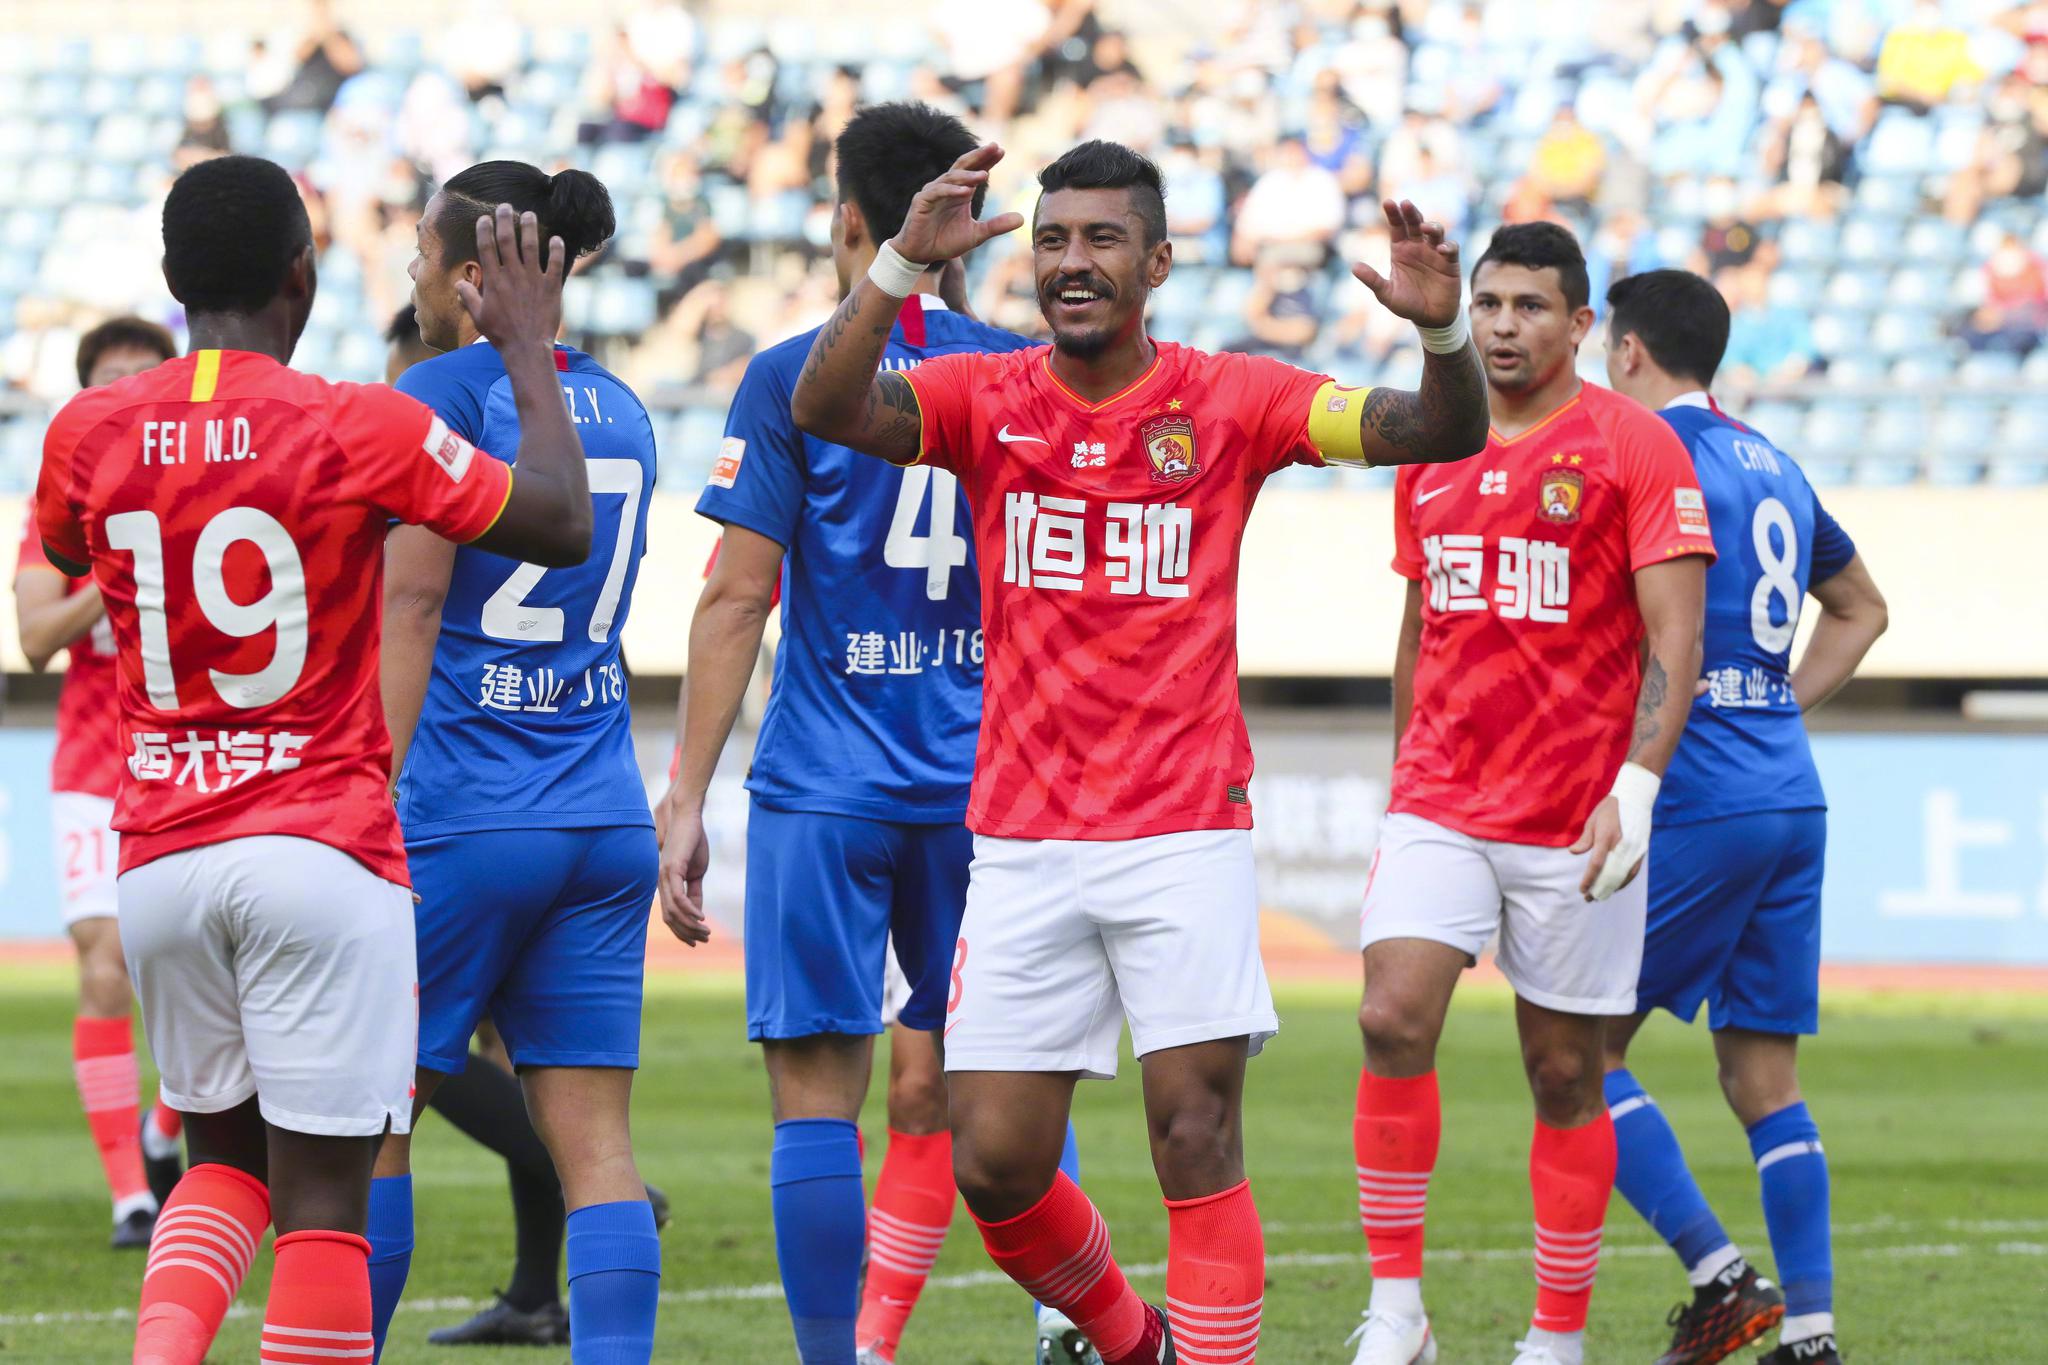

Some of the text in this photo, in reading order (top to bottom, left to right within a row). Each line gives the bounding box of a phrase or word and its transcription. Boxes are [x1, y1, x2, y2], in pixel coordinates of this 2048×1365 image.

[143, 416, 258, 465] FEI N.D.
[883, 464, 967, 601] 4
[1003, 491, 1192, 597] 恒驰
[1422, 534, 1570, 623] 恒驰
[1751, 497, 1801, 654] 8
[105, 506, 308, 710] 19
[127, 730, 313, 793] 恒大汽车
[64, 827, 105, 880] 21
[1878, 788, 2048, 920] 上
